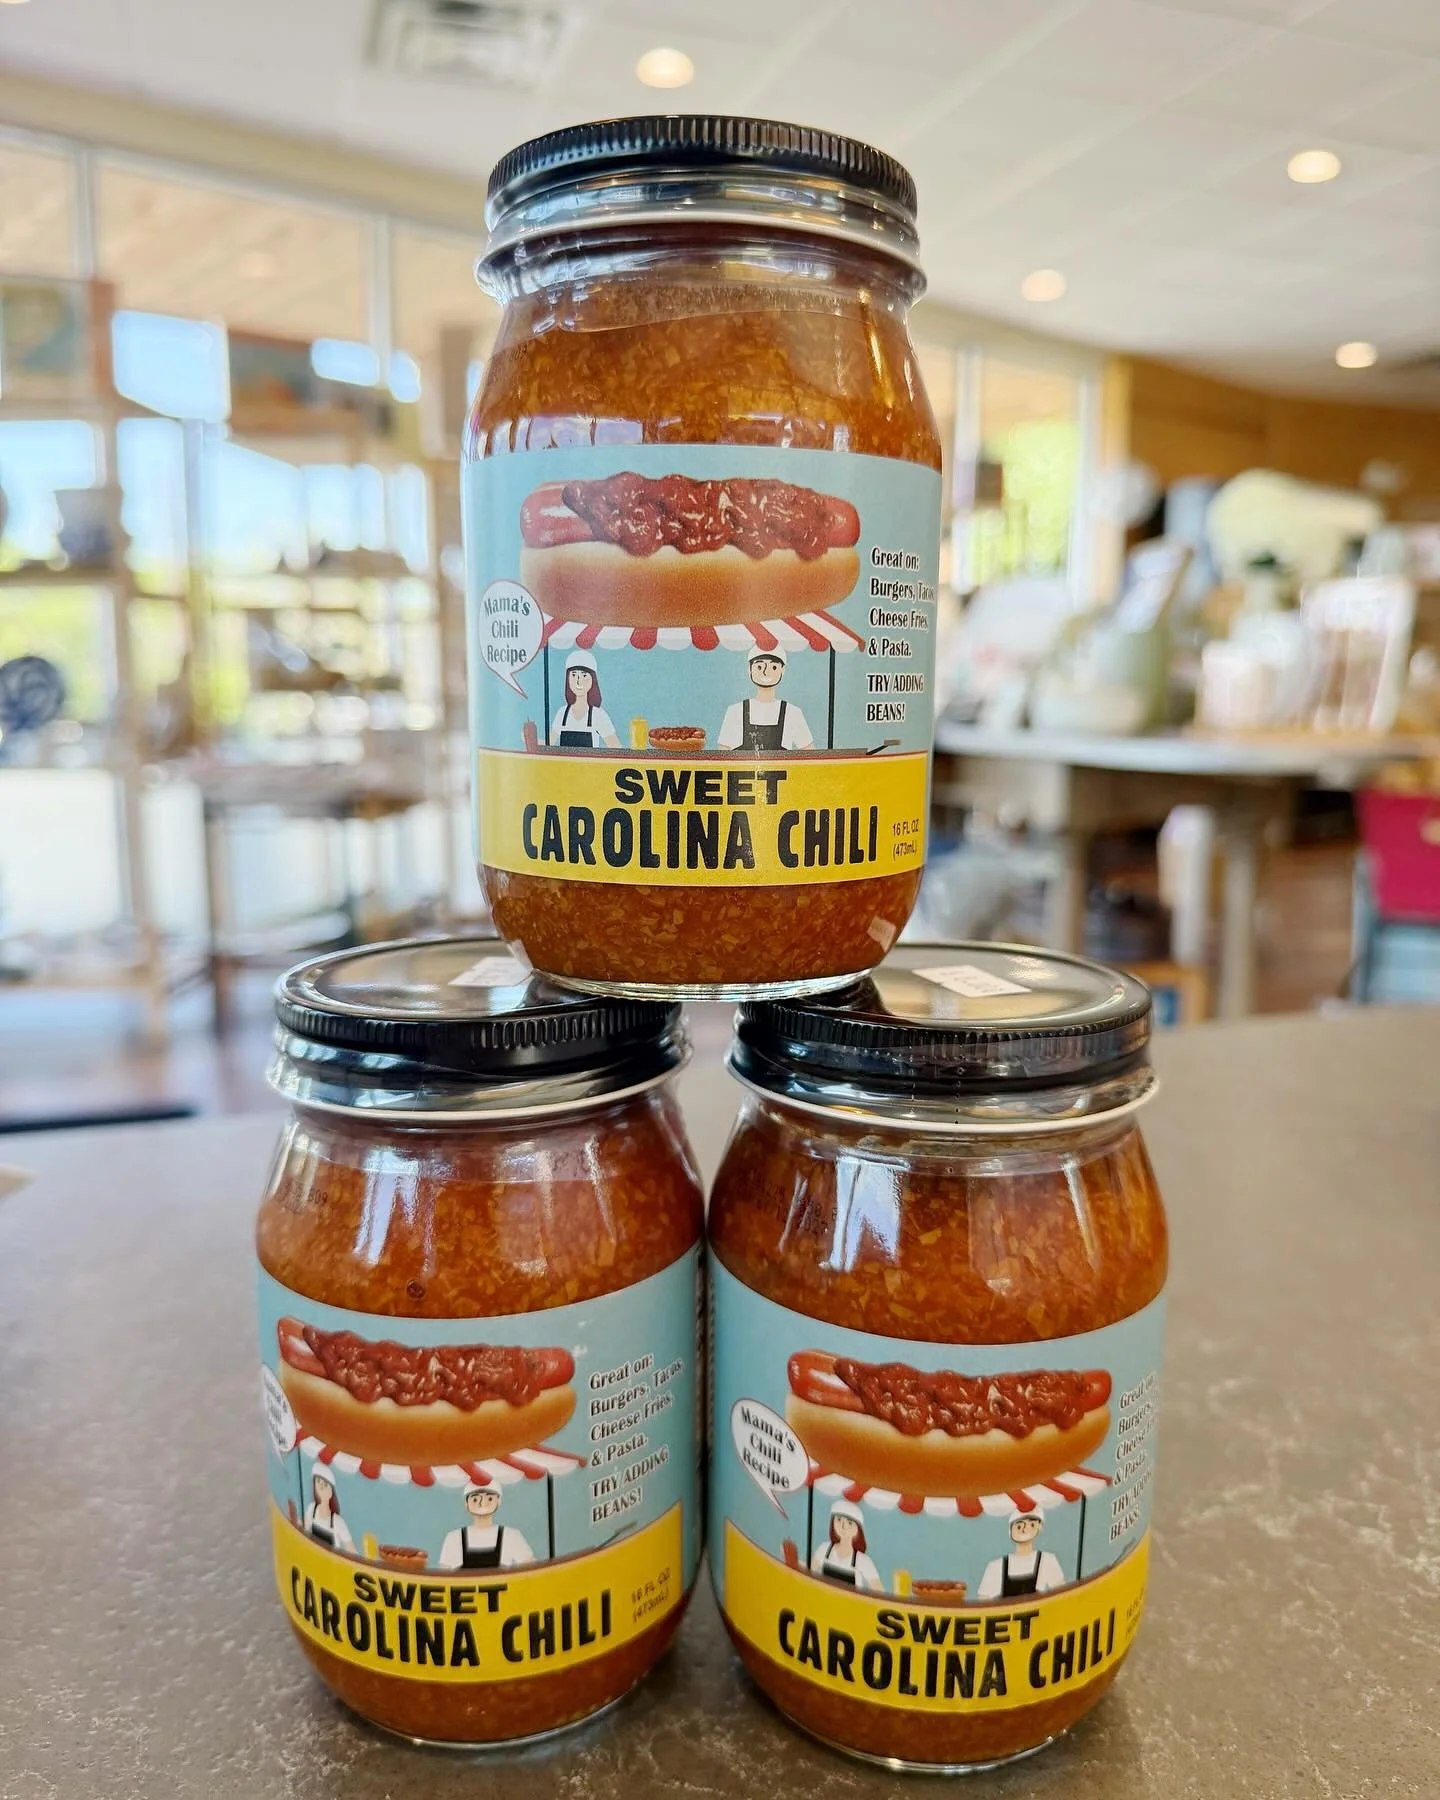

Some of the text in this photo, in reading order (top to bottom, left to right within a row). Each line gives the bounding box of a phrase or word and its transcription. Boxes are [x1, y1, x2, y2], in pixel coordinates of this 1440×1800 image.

[871, 547, 920, 570] Great on:
[870, 577, 916, 602] Burgers,
[484, 595, 531, 617] Mama's
[869, 607, 908, 627] Cheese
[491, 620, 518, 639] Chili
[487, 644, 527, 666] Recipe
[868, 638, 912, 657] & Pasta.
[867, 674, 924, 692] TRY ADDING
[866, 703, 905, 722] BEANS!
[614, 768, 787, 806] SWEET
[522, 803, 878, 870] CAROLINA CHILI
[893, 818, 919, 837] 16 FL OZ
[590, 1354, 653, 1390] Great on:
[590, 1384, 650, 1416] Burgers,
[590, 1410, 640, 1441] Cheese
[741, 1406, 796, 1453] Mama's
[591, 1433, 647, 1467] & Pasta.
[750, 1432, 782, 1465] Chili
[591, 1447, 669, 1497] TRY ADDING
[743, 1447, 790, 1489] Recipe
[592, 1486, 642, 1522] BEANS!
[1112, 1493, 1131, 1516] TRY
[353, 1571, 508, 1615] SWEET
[291, 1566, 612, 1667] CAROLINA CHILI
[875, 1609, 1040, 1646] SWEET
[778, 1607, 1116, 1699] CAROLINA CHILI
